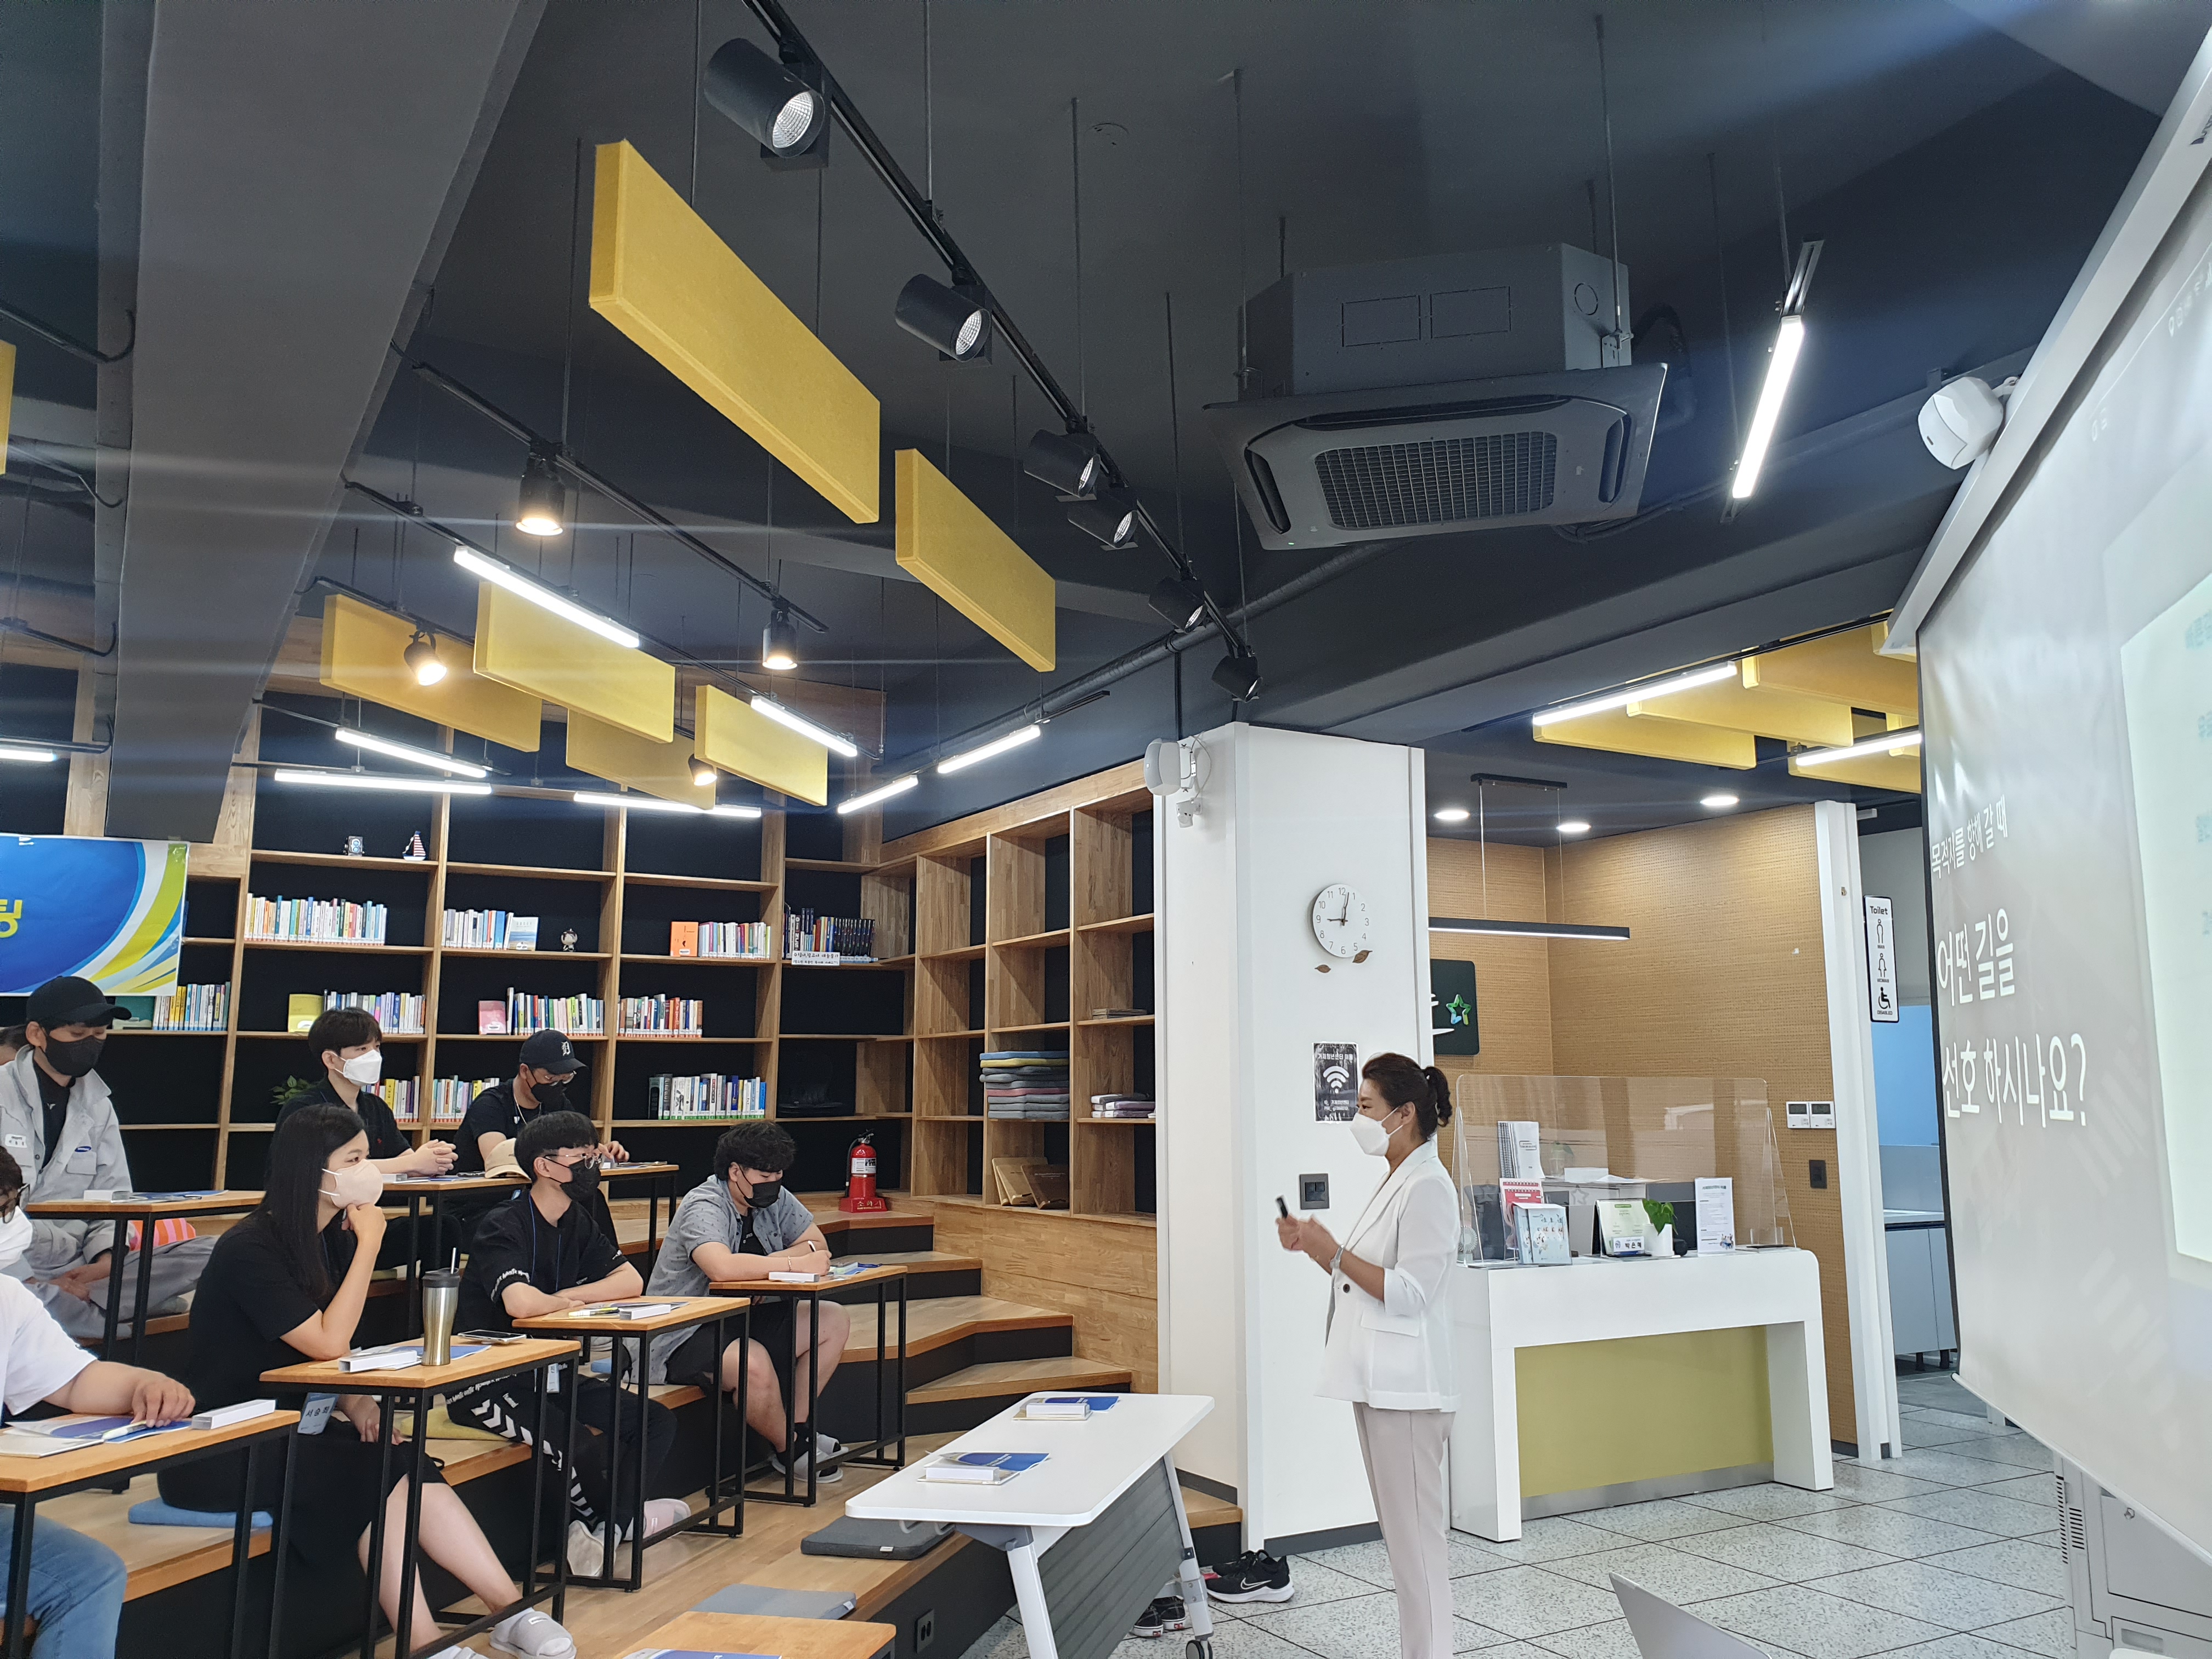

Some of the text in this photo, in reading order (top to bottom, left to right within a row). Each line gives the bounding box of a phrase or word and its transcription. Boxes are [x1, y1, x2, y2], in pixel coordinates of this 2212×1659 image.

[1932, 794, 2008, 879] 목적지를 향해 갈 때
[1327, 890, 1333, 899] 11
[1338, 887, 1346, 895] 12
[1318, 900, 1326, 909] 10
[1361, 903, 1365, 911] 2
[1870, 906, 1888, 915] Toilet
[1316, 915, 1321, 923] 9
[1364, 917, 1369, 926] 3
[1319, 930, 1325, 939] 8
[1329, 941, 1334, 950] 7
[1353, 943, 1358, 951] 5
[1341, 946, 1346, 955] 6
[1937, 909, 2015, 1007] 어떤 길을
[1943, 1033, 2087, 1128] 선호 하시나요?
